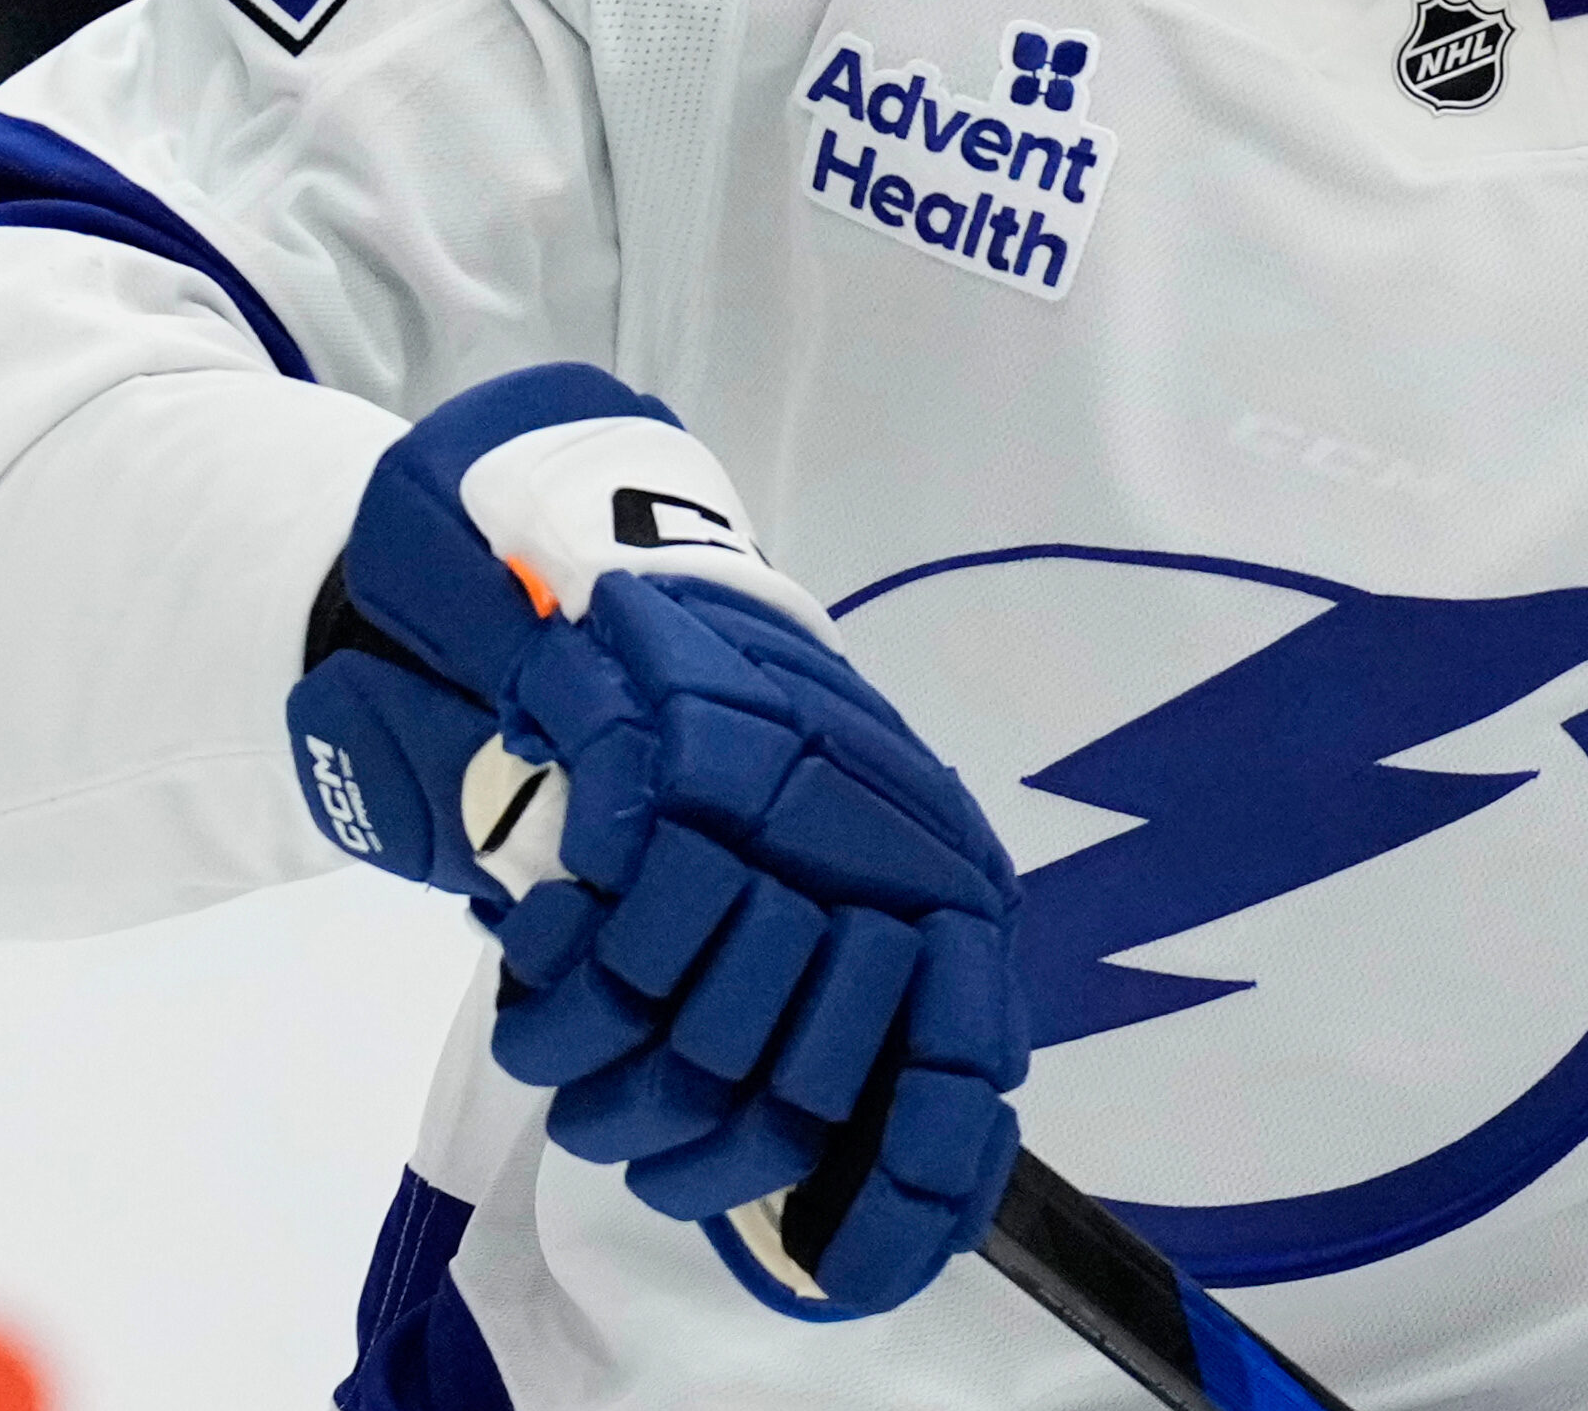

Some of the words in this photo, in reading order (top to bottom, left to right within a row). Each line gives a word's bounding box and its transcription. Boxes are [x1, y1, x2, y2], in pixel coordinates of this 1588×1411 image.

[807, 47, 1098, 204] Advent
[1416, 31, 1494, 83] NHL
[812, 128, 1068, 288] Health
[306, 734, 370, 854] CCM
